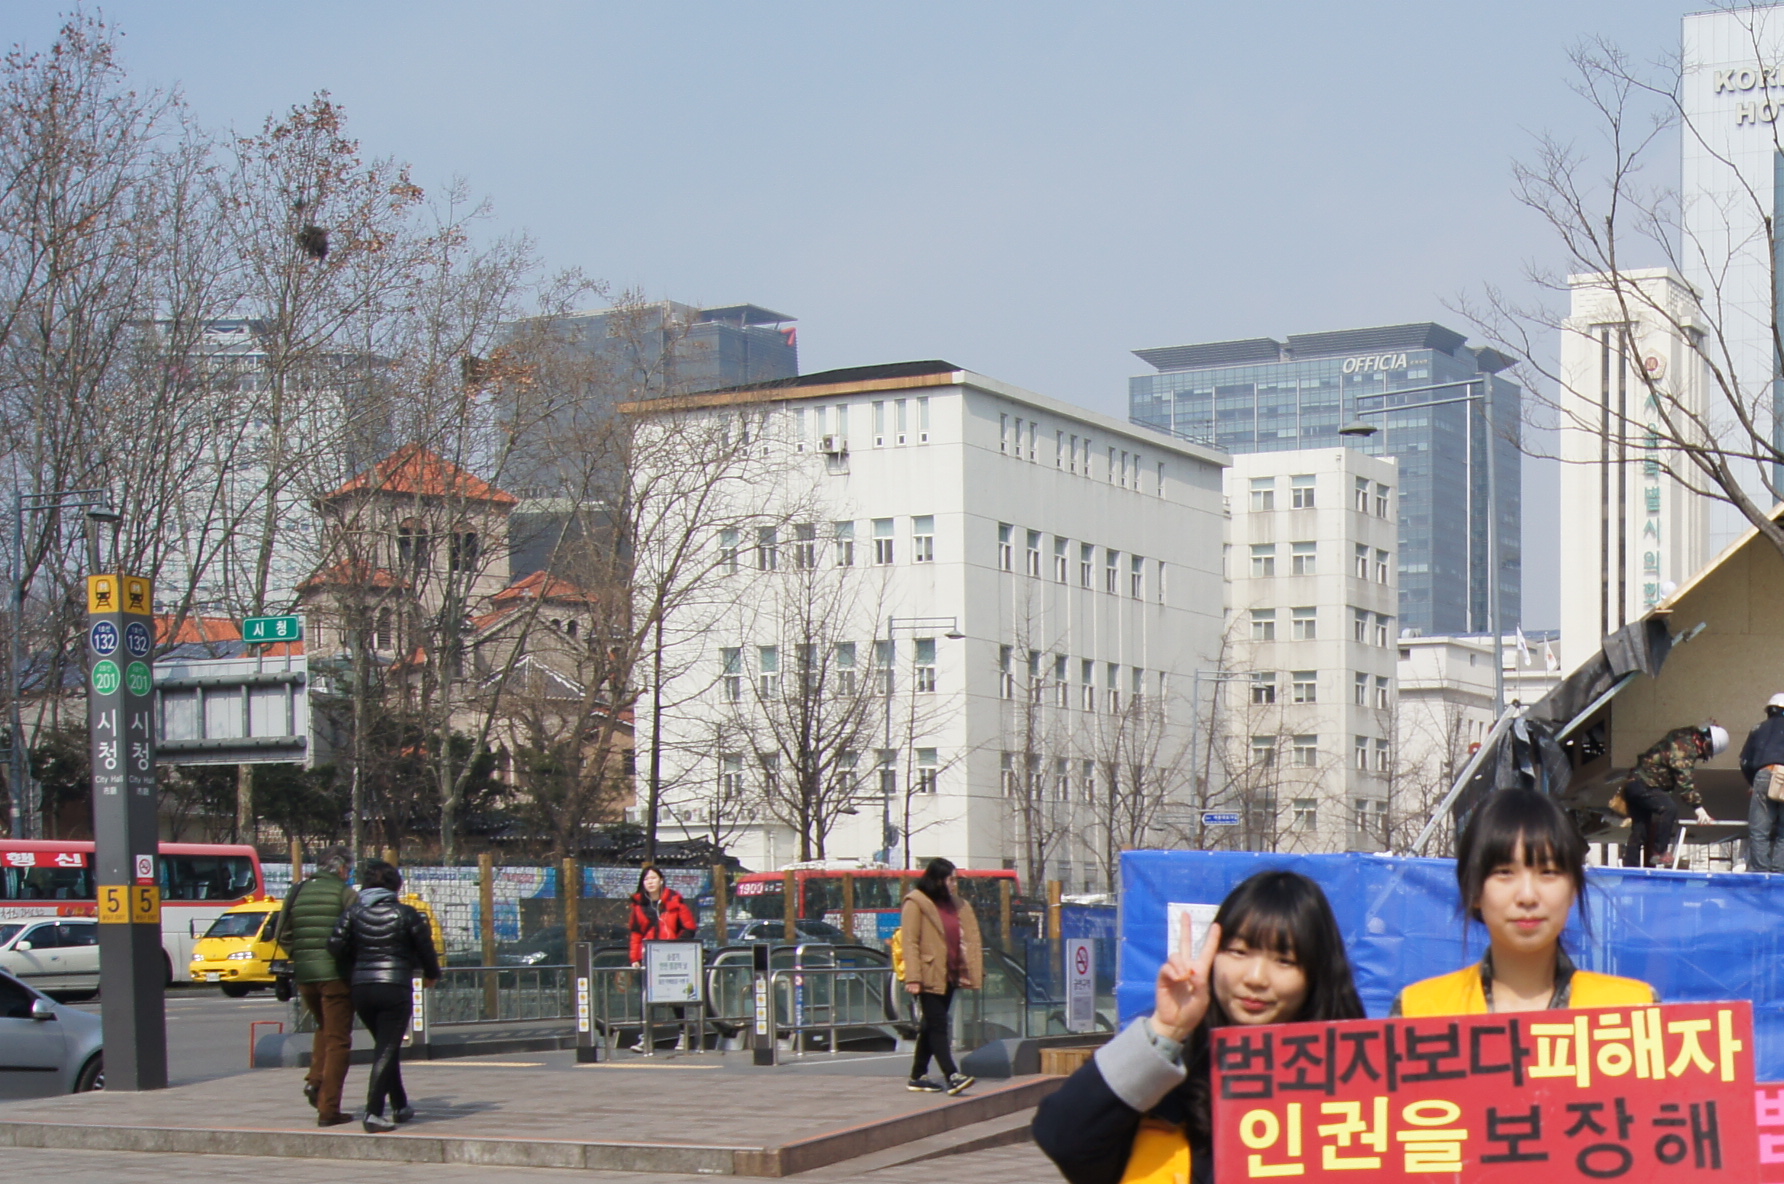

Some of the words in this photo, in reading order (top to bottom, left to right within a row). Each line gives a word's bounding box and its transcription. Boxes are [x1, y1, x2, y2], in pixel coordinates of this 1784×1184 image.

[1342, 353, 1408, 374] OFFICIA
[253, 620, 287, 637] 시청
[94, 634, 115, 650] 132
[128, 635, 147, 652] 132
[96, 673, 116, 689] 201
[130, 674, 148, 690] 201
[97, 708, 117, 770] 시청
[131, 711, 149, 771] 시청
[95, 775, 108, 784] City
[111, 775, 124, 783] Hall
[129, 775, 141, 784] City
[738, 882, 764, 895] 1900
[107, 889, 120, 913] 5
[140, 889, 152, 913] 5
[1239, 1097, 1469, 1177] 인권을
